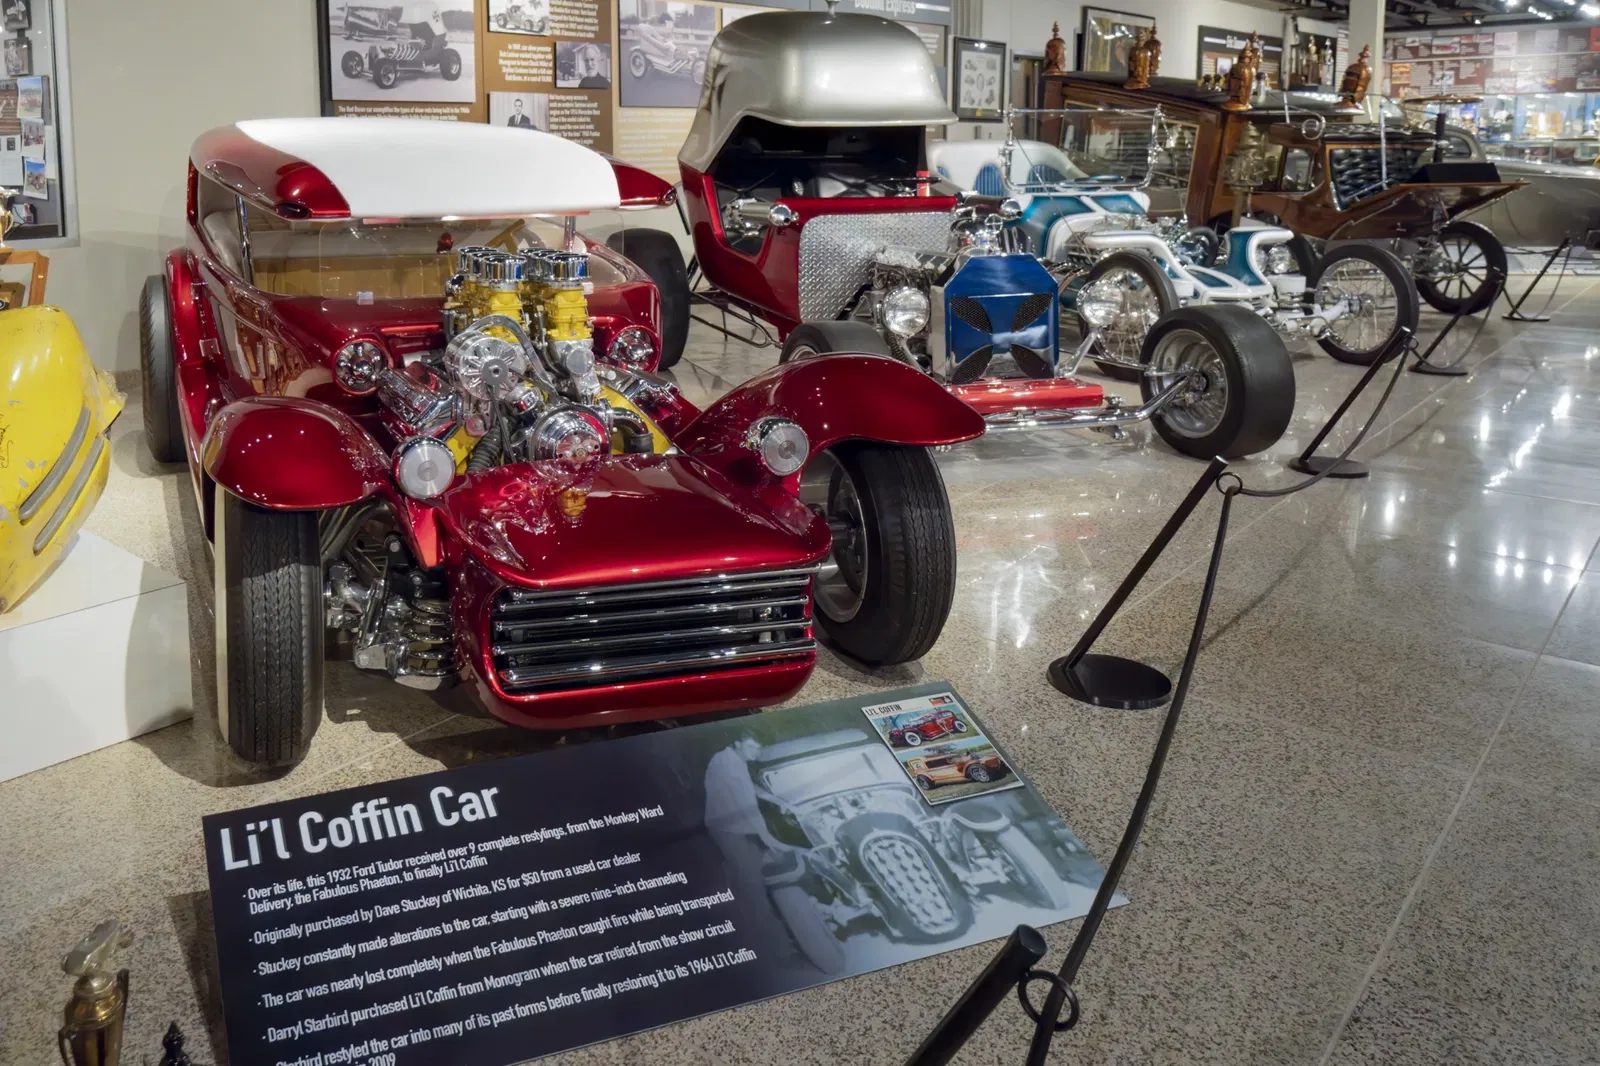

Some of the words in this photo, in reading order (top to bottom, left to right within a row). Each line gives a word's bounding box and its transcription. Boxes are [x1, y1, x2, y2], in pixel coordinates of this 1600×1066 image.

[879, 704, 902, 714] COFFIN
[247, 886, 273, 900] Over
[273, 882, 287, 895] its
[306, 873, 327, 888] this
[326, 867, 353, 884] 1932
[352, 862, 376, 878] Ford
[375, 858, 404, 873] Tudor
[404, 847, 447, 868] received
[446, 846, 468, 859] over
[468, 841, 476, 854] 9
[477, 834, 521, 853] complete
[566, 822, 590, 834] from
[588, 817, 605, 830] the
[603, 811, 640, 827] Monkey
[637, 804, 665, 820] Ward
[298, 796, 423, 854] Coffin
[429, 785, 499, 827] Car
[254, 923, 303, 945] Originally
[304, 909, 360, 937] purchased
[359, 908, 373, 923] by
[374, 904, 401, 918] Dave
[400, 895, 441, 912] Stuckey
[441, 889, 453, 904] of
[490, 878, 507, 893] KS
[506, 876, 521, 890] for
[520, 871, 541, 887] $50
[540, 869, 565, 882] from
[564, 867, 573, 877] a
[571, 859, 597, 876] used
[596, 858, 612, 870] car
[612, 852, 641, 867] dealer
[258, 956, 301, 976] Stuckey
[303, 942, 357, 966] constantly
[357, 935, 389, 954] made
[389, 925, 443, 946] alterations
[441, 922, 454, 934] to
[452, 918, 471, 932] the
[490, 906, 529, 924] starting
[527, 899, 551, 915] with
[549, 900, 559, 910] a
[557, 893, 591, 909] severe
[636, 871, 688, 891] channeling
[293, 892, 312, 905] the
[312, 883, 359, 902] Fabulous
[402, 870, 414, 882] to
[413, 863, 443, 880] finally
[459, 854, 488, 870] Coffin
[261, 993, 284, 1008] The
[285, 989, 304, 1003] car
[305, 983, 329, 998] was
[330, 973, 364, 993] nearly
[364, 968, 386, 984] lost
[386, 955, 443, 980] completely
[443, 950, 474, 966] when
[472, 945, 491, 959] the
[490, 935, 538, 955] Fabulous
[536, 926, 579, 945] Phaeton
[578, 916, 613, 935] caught
[610, 914, 630, 928] fire
[628, 907, 656, 923] while
[653, 902, 684, 918] being
[680, 887, 735, 911] transported
[267, 1020, 304, 1043] Darryl
[304, 1009, 350, 1034] Starbird
[350, 995, 409, 1026] purchased
[425, 985, 458, 1004] Coffin
[457, 981, 485, 997] from
[483, 968, 541, 991] Monogram
[540, 960, 571, 977] when
[568, 955, 588, 970] the
[587, 952, 604, 966] car
[604, 941, 639, 962] retired
[636, 939, 663, 954] from
[660, 934, 679, 948] the
[678, 928, 705, 944] show
[704, 919, 736, 938] circuit
[323, 1040, 369, 1064] restyled
[369, 1038, 390, 1054] the
[390, 1034, 409, 1050] car
[409, 1027, 432, 1044] into
[432, 1021, 463, 1039] many
[464, 1014, 477, 1031] of
[475, 1013, 491, 1028] its
[491, 1006, 517, 1028] past
[514, 1000, 548, 1018] forms
[546, 992, 582, 1010] before
[580, 982, 613, 1002] finally
[612, 973, 659, 994] restoring
[655, 969, 667, 983] it
[663, 968, 677, 981] to
[673, 964, 690, 978] its
[687, 957, 714, 975] 1964
[726, 947, 757, 965] Coffin
